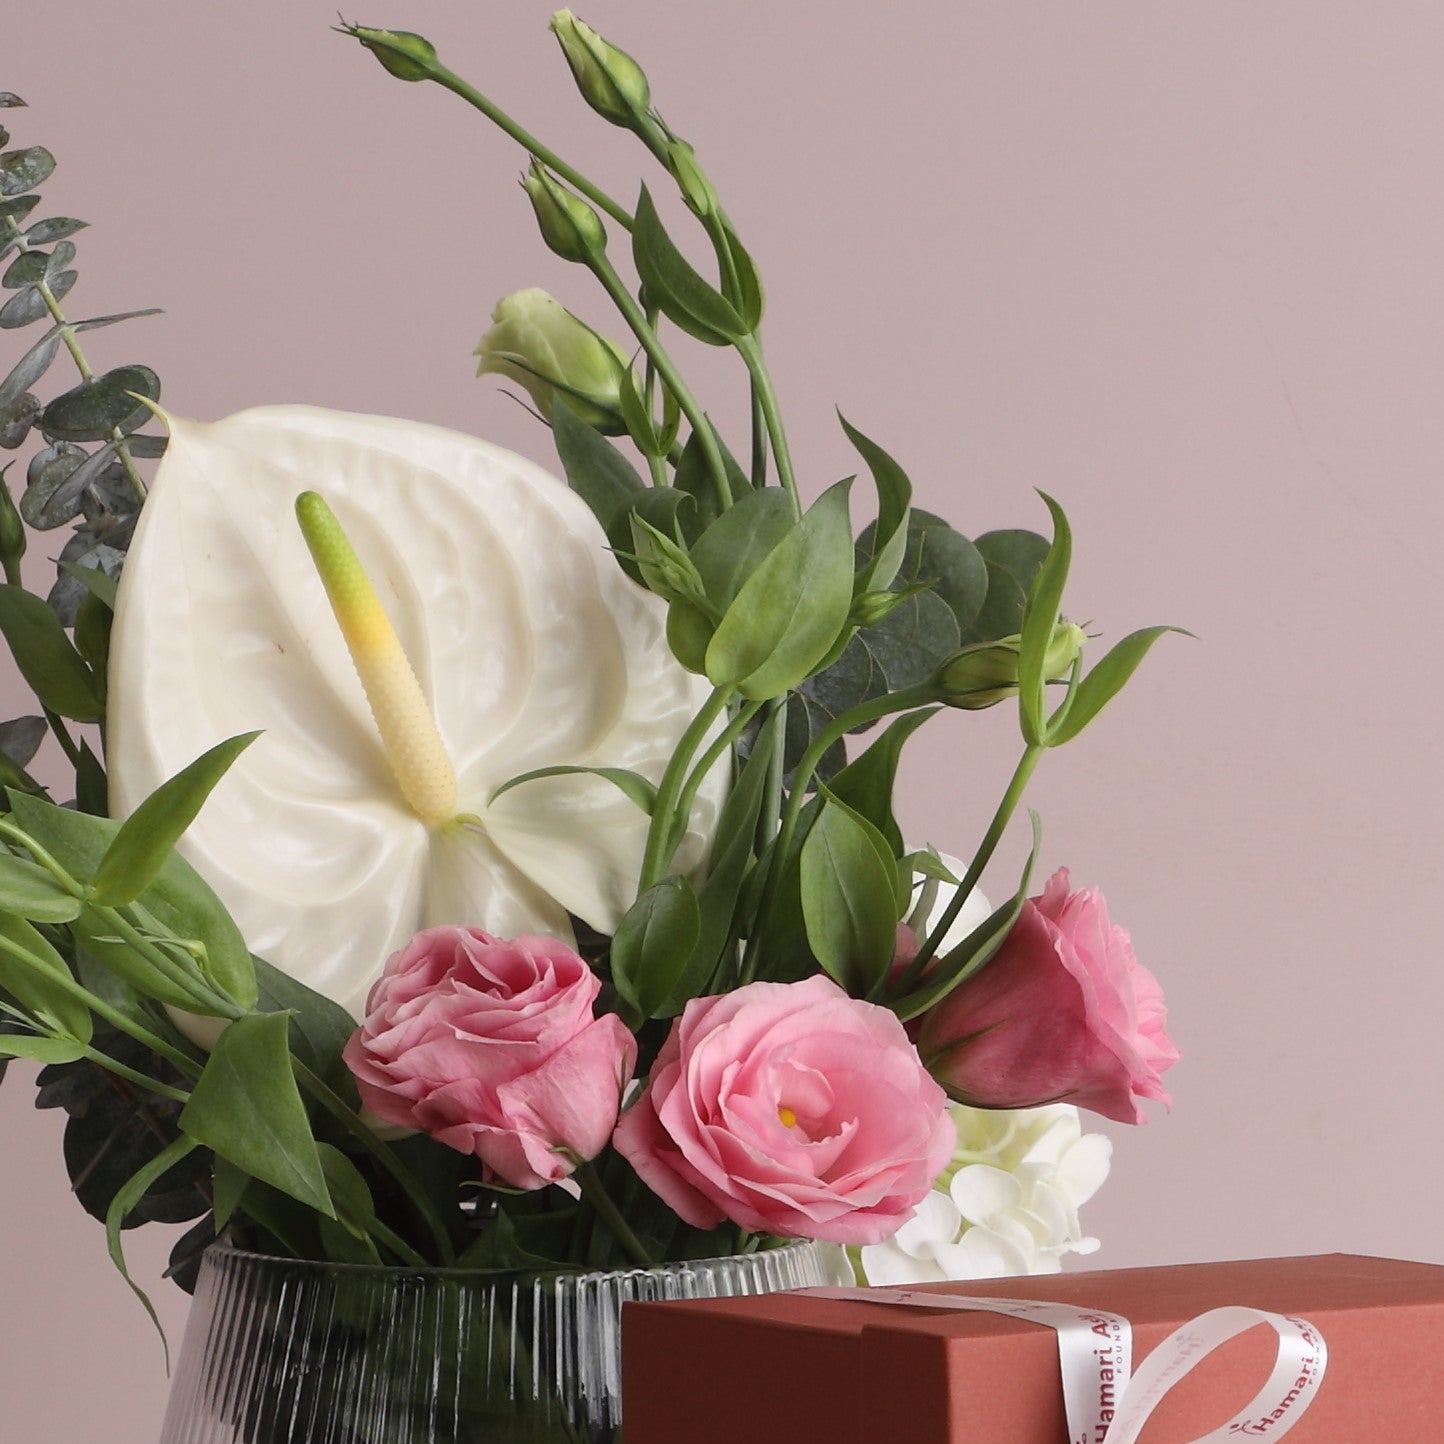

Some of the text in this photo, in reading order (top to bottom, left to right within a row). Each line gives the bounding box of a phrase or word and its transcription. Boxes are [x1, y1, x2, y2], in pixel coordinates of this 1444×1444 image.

[1110, 1319, 1123, 1374] FOUND
[1094, 1346, 1115, 1444] Hamari
[1252, 1357, 1314, 1432] Hamari
